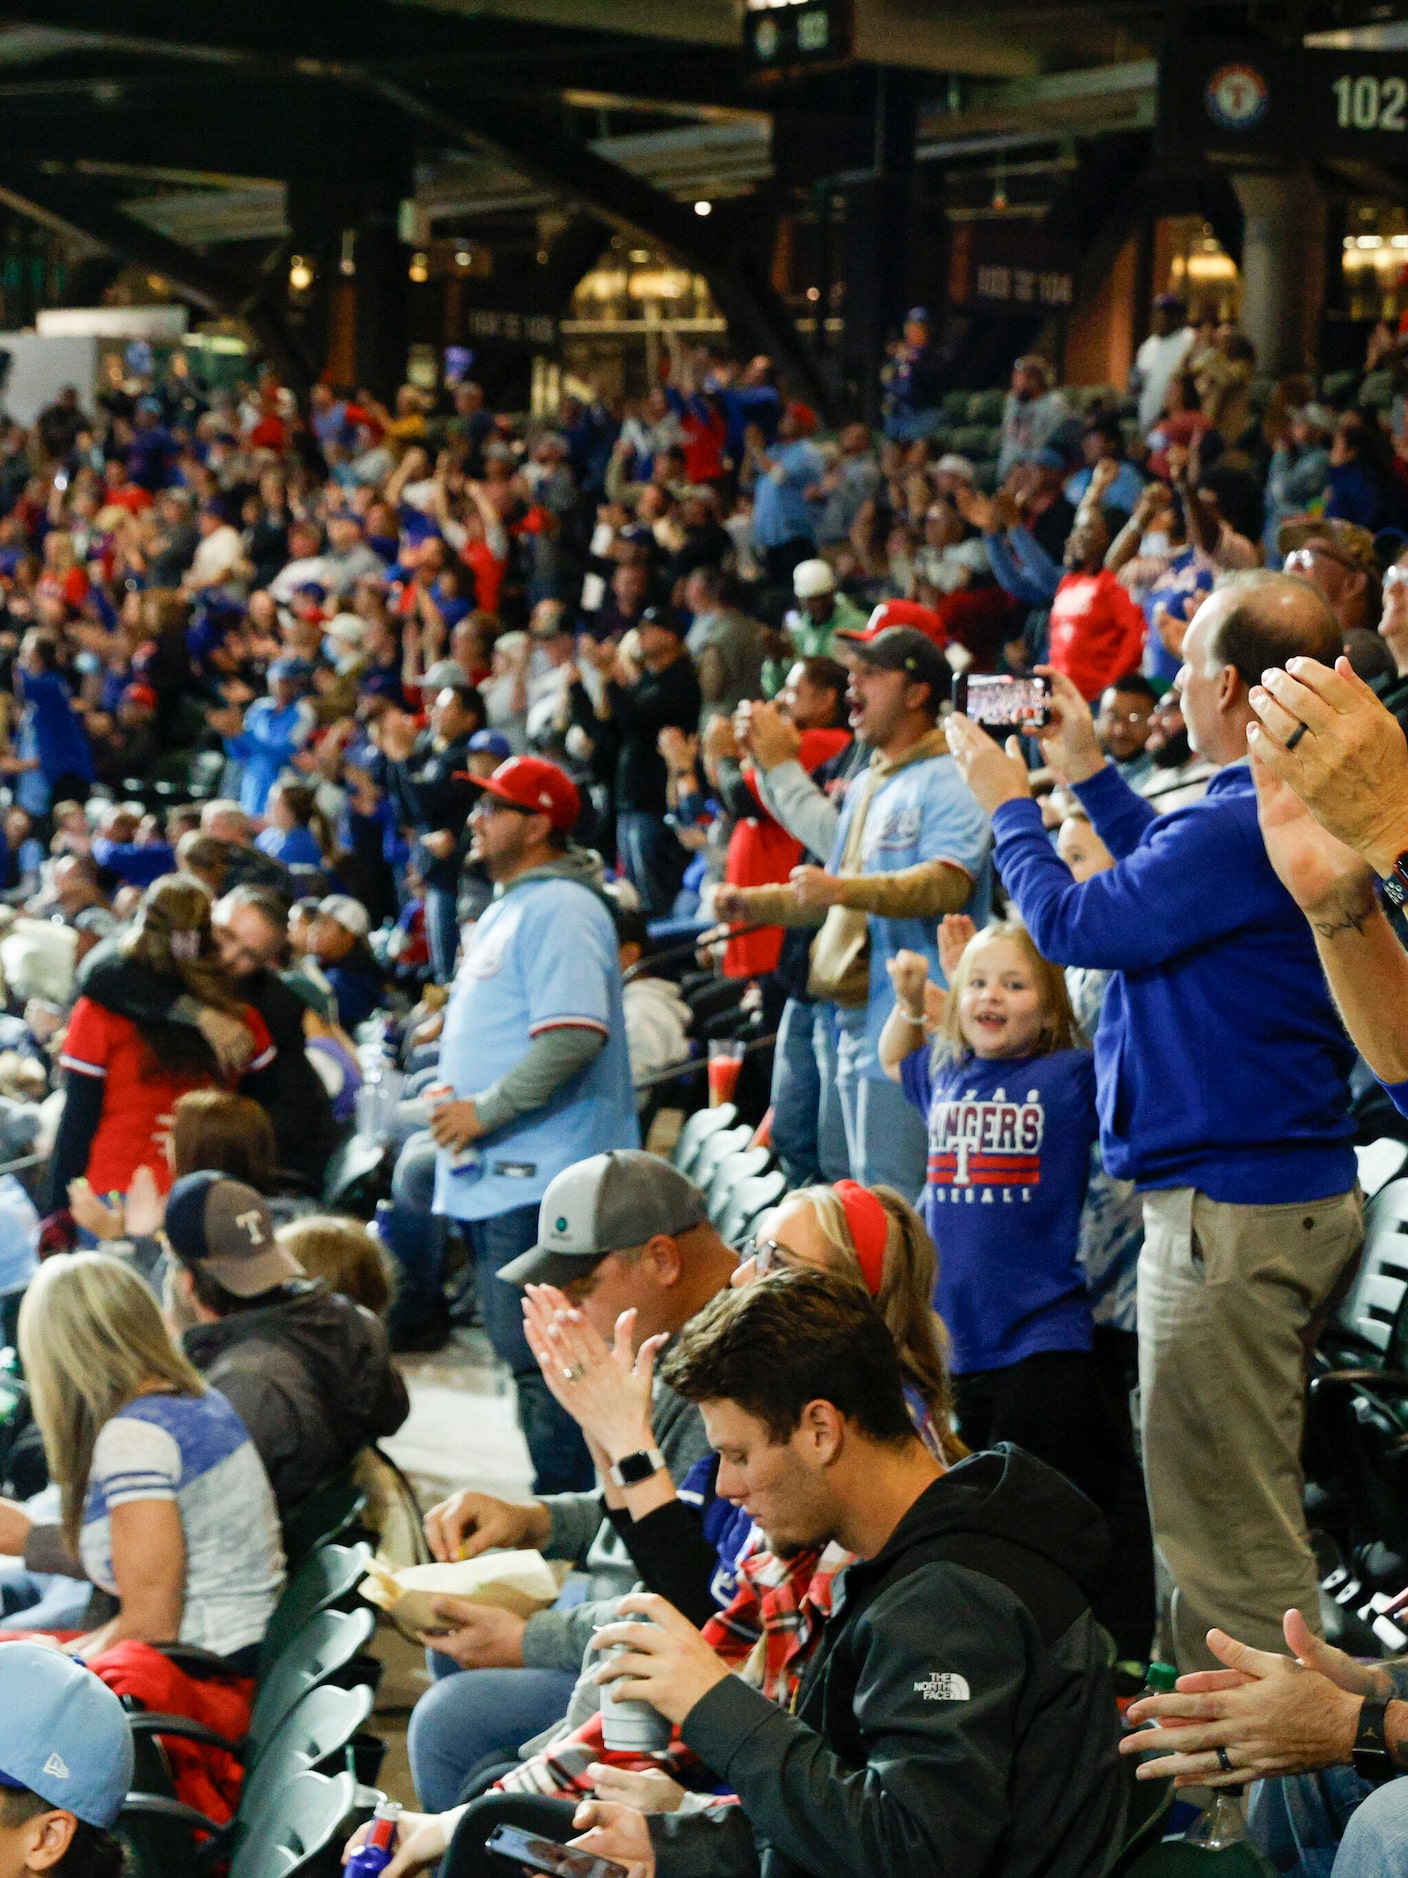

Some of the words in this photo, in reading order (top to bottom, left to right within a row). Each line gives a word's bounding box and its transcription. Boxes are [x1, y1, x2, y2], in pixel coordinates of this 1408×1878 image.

[1333, 75, 1408, 130] 102
[236, 1210, 265, 1245] T
[929, 1672, 951, 1682] THE
[913, 1681, 951, 1692] NORTH
[923, 1690, 951, 1700] FACE
